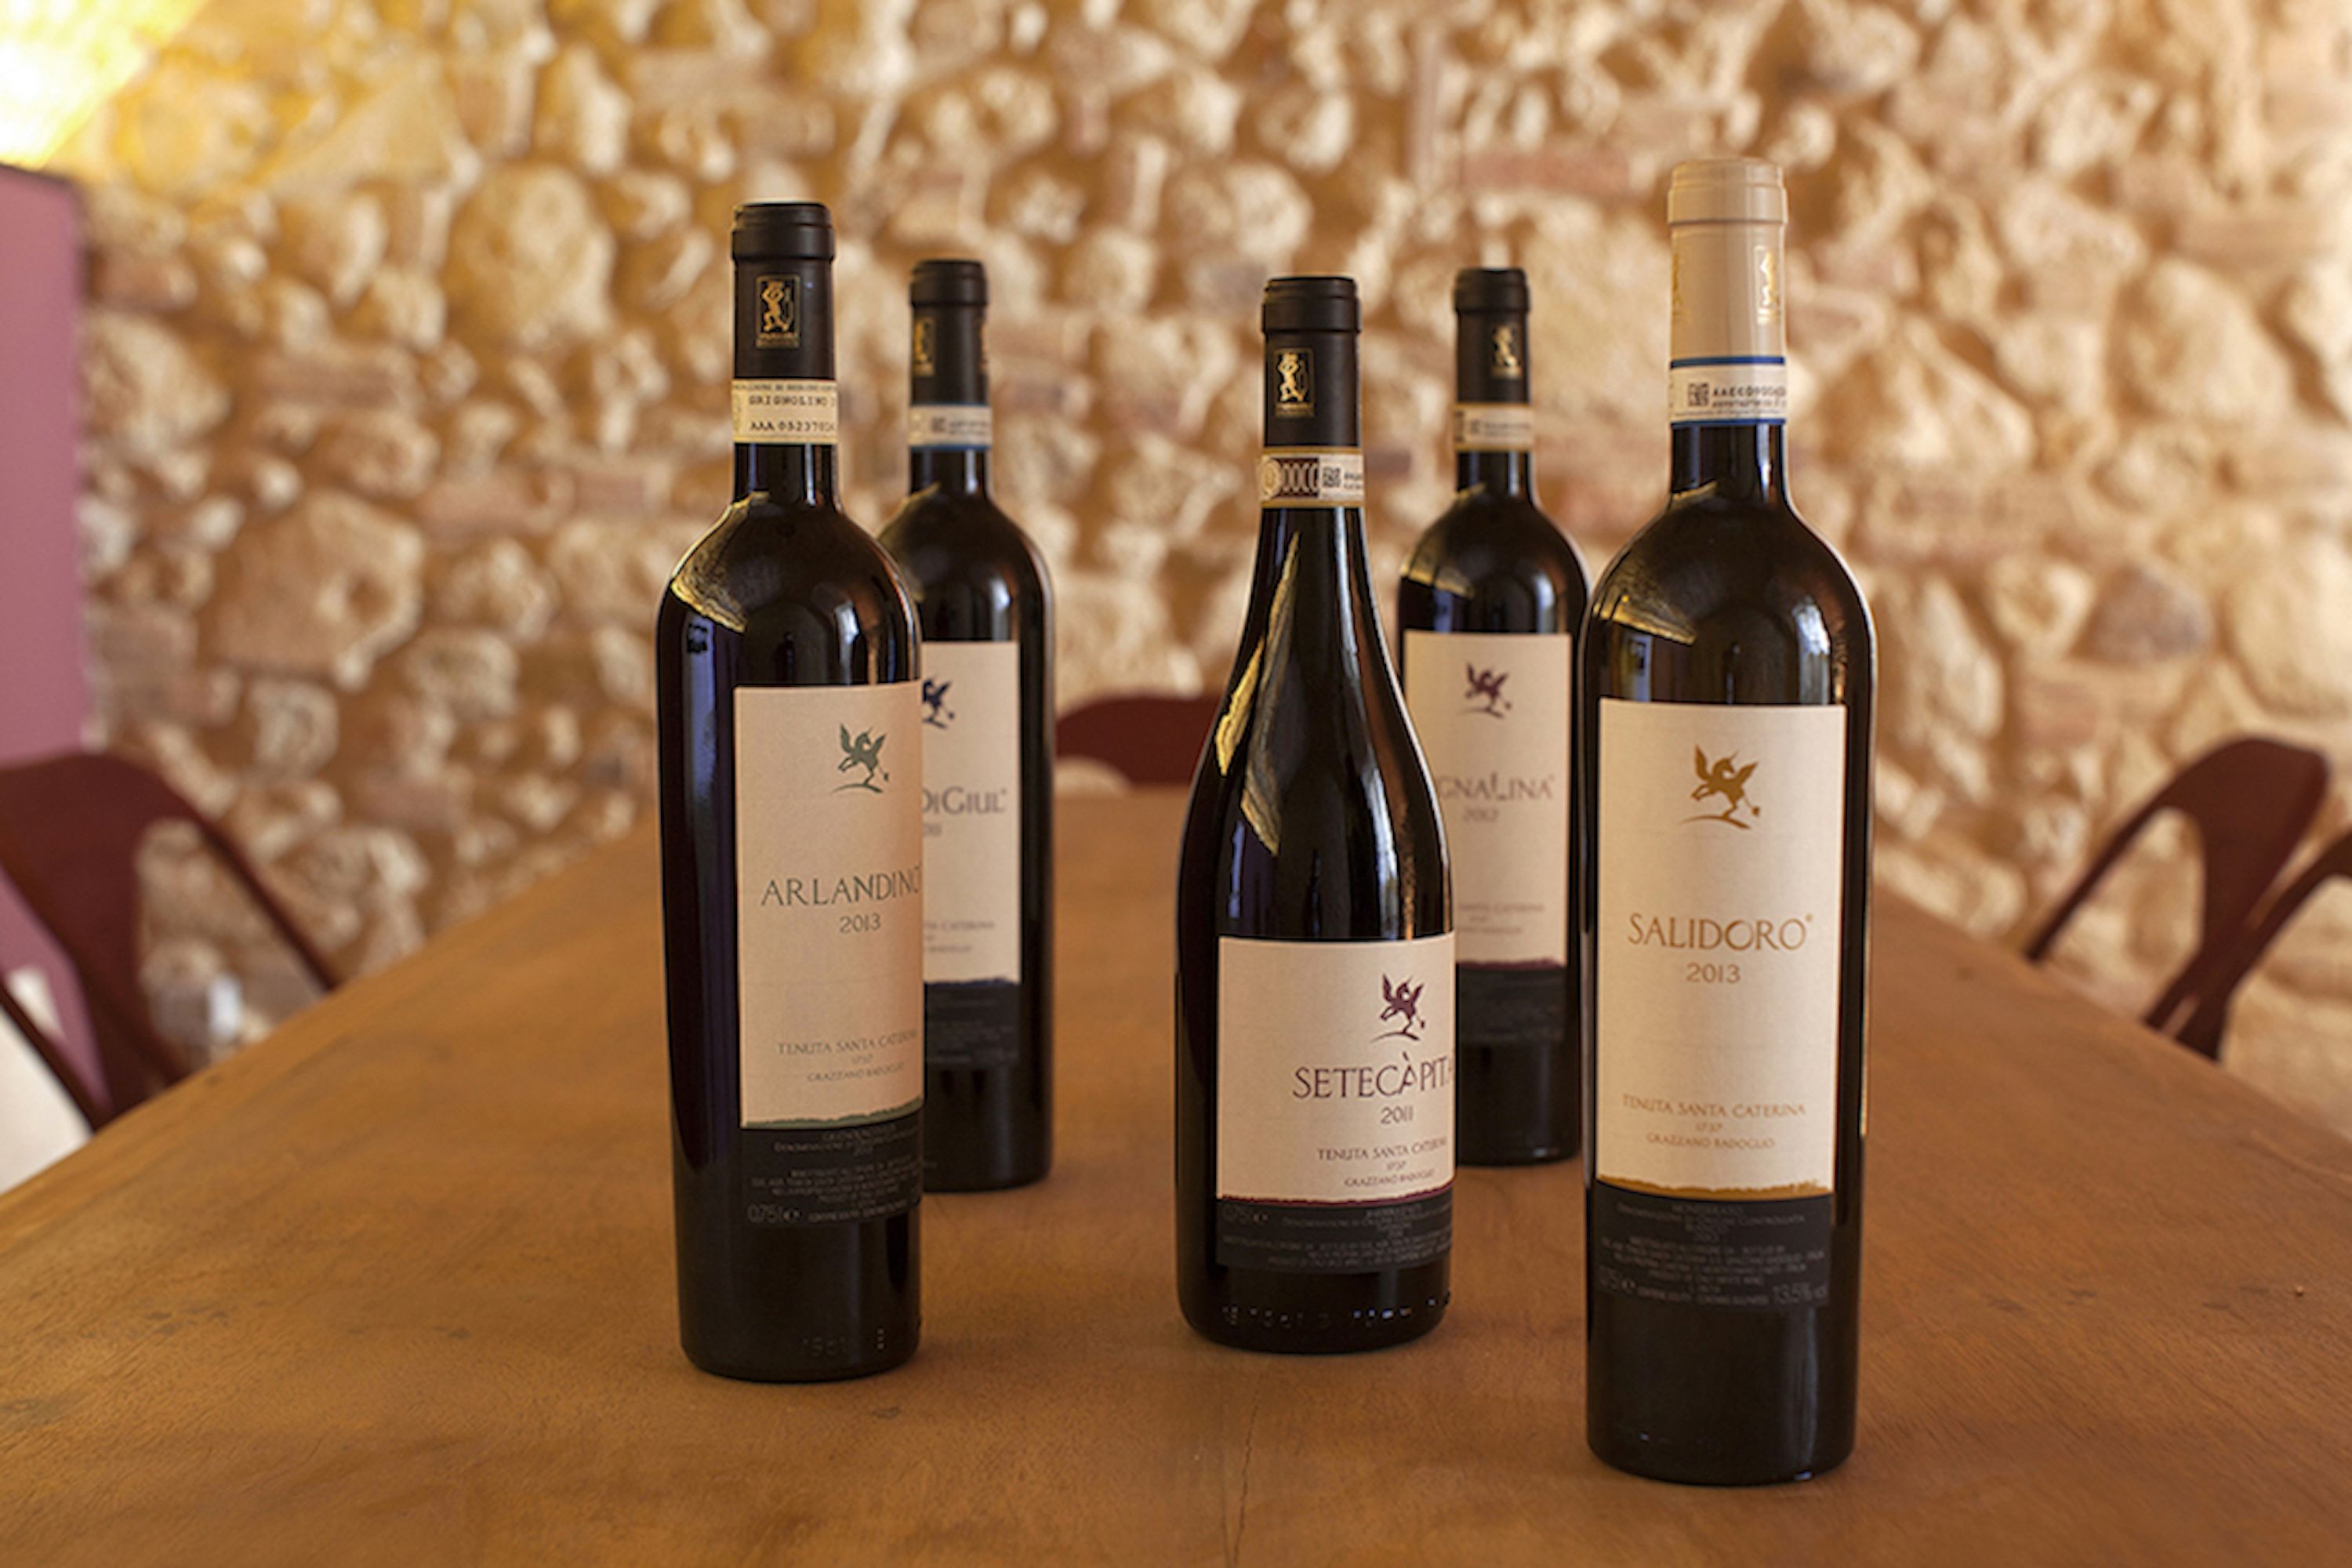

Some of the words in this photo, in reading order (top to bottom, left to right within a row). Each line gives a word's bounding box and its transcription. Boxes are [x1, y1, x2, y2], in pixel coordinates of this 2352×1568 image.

[839, 913, 882, 934] 2013
[1686, 961, 1741, 984] 2013
[778, 1042, 831, 1055] TENUTA
[836, 1037, 875, 1053] SANTA
[1381, 1105, 1414, 1125] 2011
[1621, 1092, 1674, 1114] TENUTA
[1676, 1101, 1726, 1118] SANTA
[1732, 1102, 1806, 1120] CATERINA
[1318, 1148, 1369, 1161] TENUTA
[1372, 1143, 1409, 1160] SANTA
